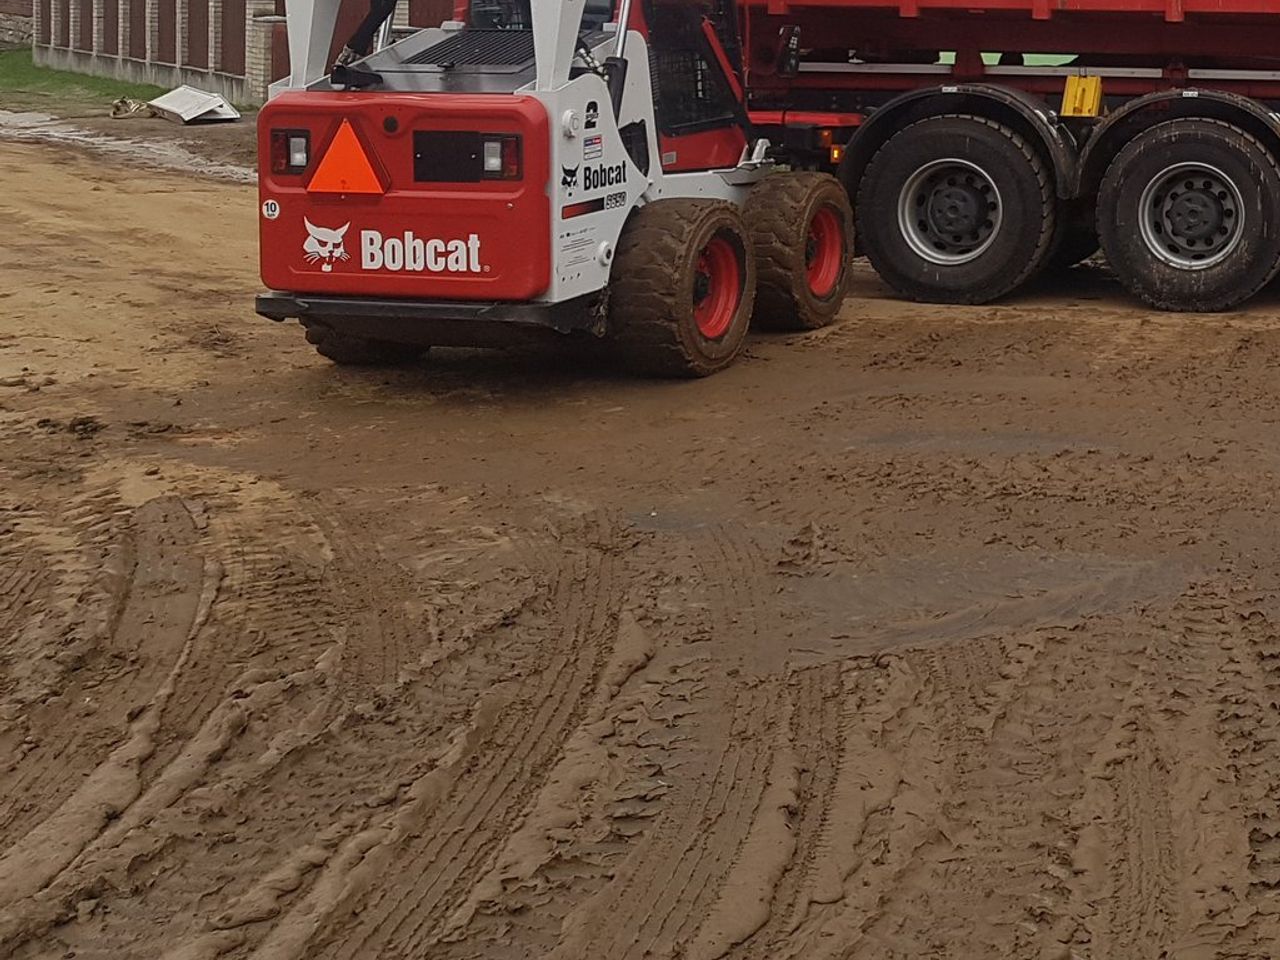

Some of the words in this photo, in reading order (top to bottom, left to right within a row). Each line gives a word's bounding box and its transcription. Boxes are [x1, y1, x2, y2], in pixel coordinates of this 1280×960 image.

[584, 160, 627, 191] Bobcat
[264, 202, 277, 213] 10
[361, 230, 481, 272] Bobcat
